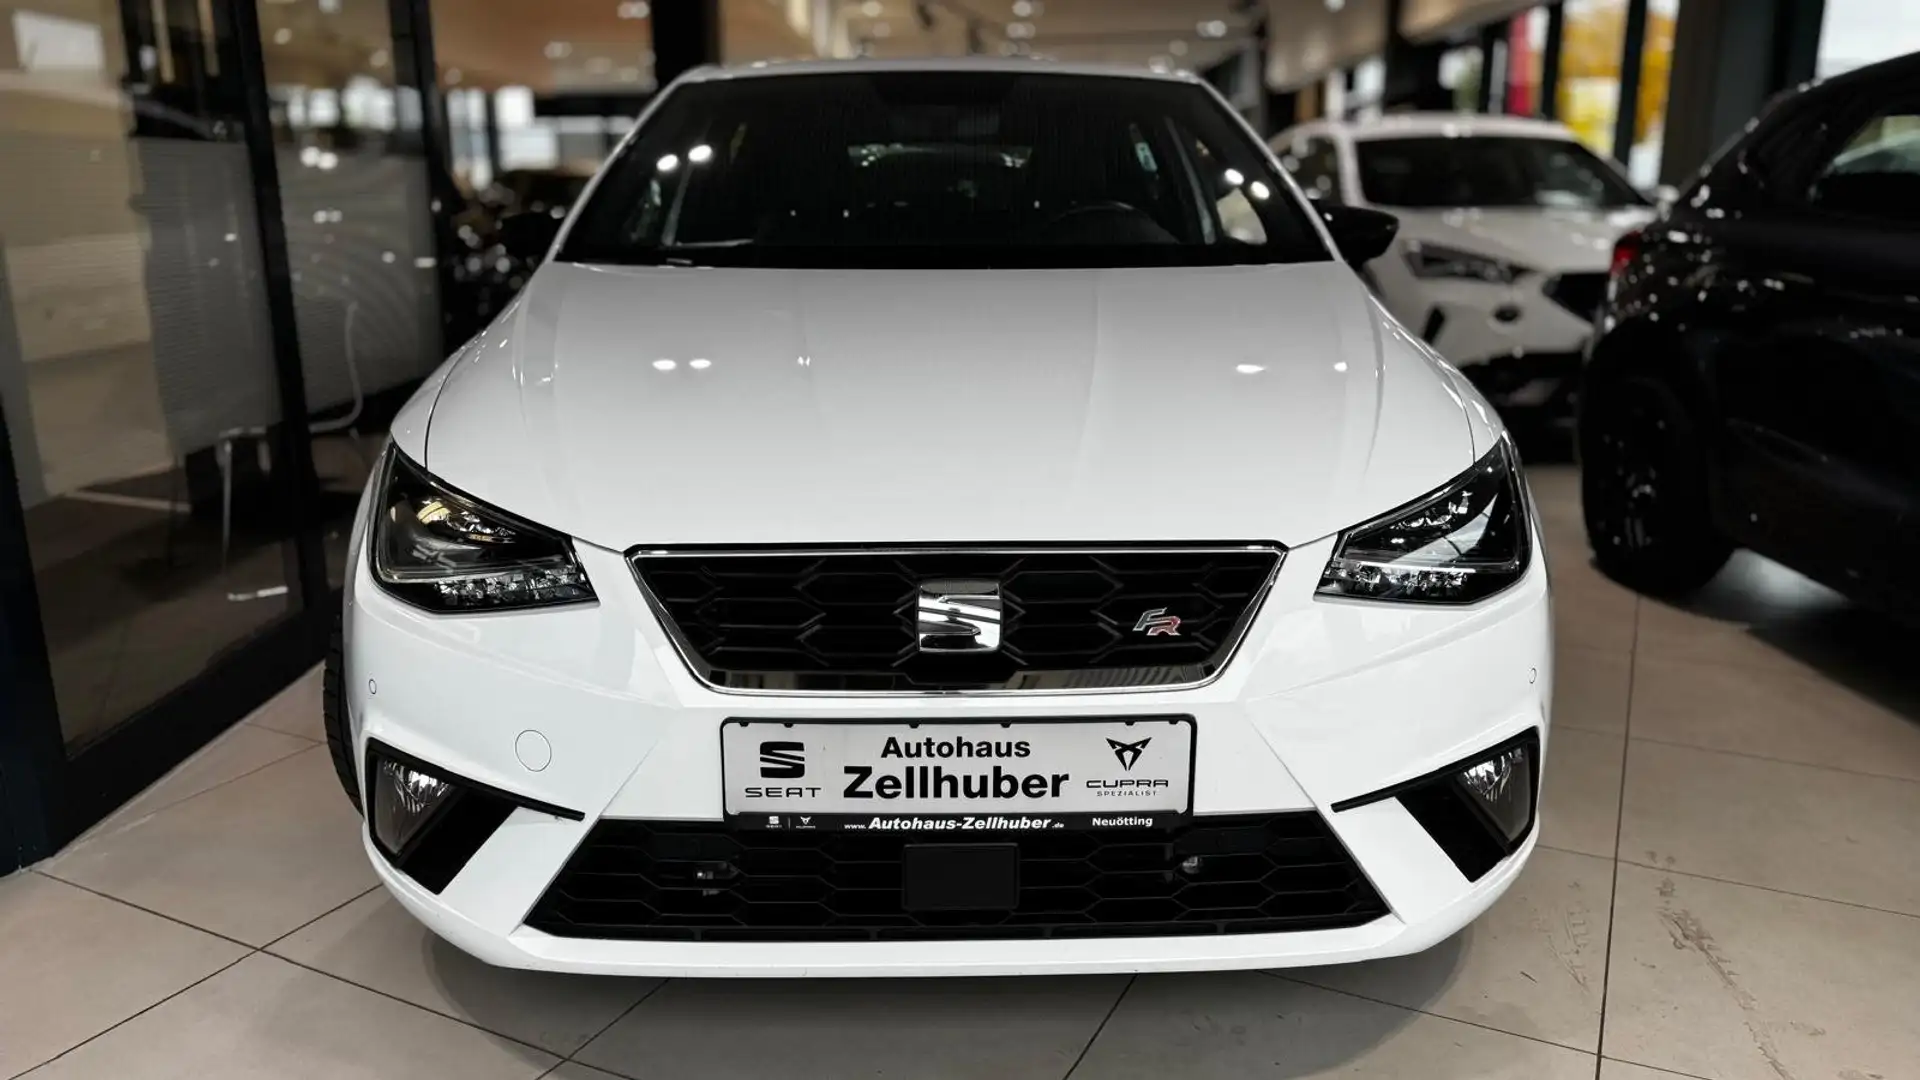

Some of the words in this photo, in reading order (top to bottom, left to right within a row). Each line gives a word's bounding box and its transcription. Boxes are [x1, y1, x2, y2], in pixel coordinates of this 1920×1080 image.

[1132, 606, 1181, 636] FR
[881, 736, 1031, 759] Autohaus
[843, 765, 1070, 799] Zellhuber
[1086, 779, 1169, 789] CUPRA
[744, 787, 822, 798] SEAT
[1092, 817, 1154, 828] Neuötting
